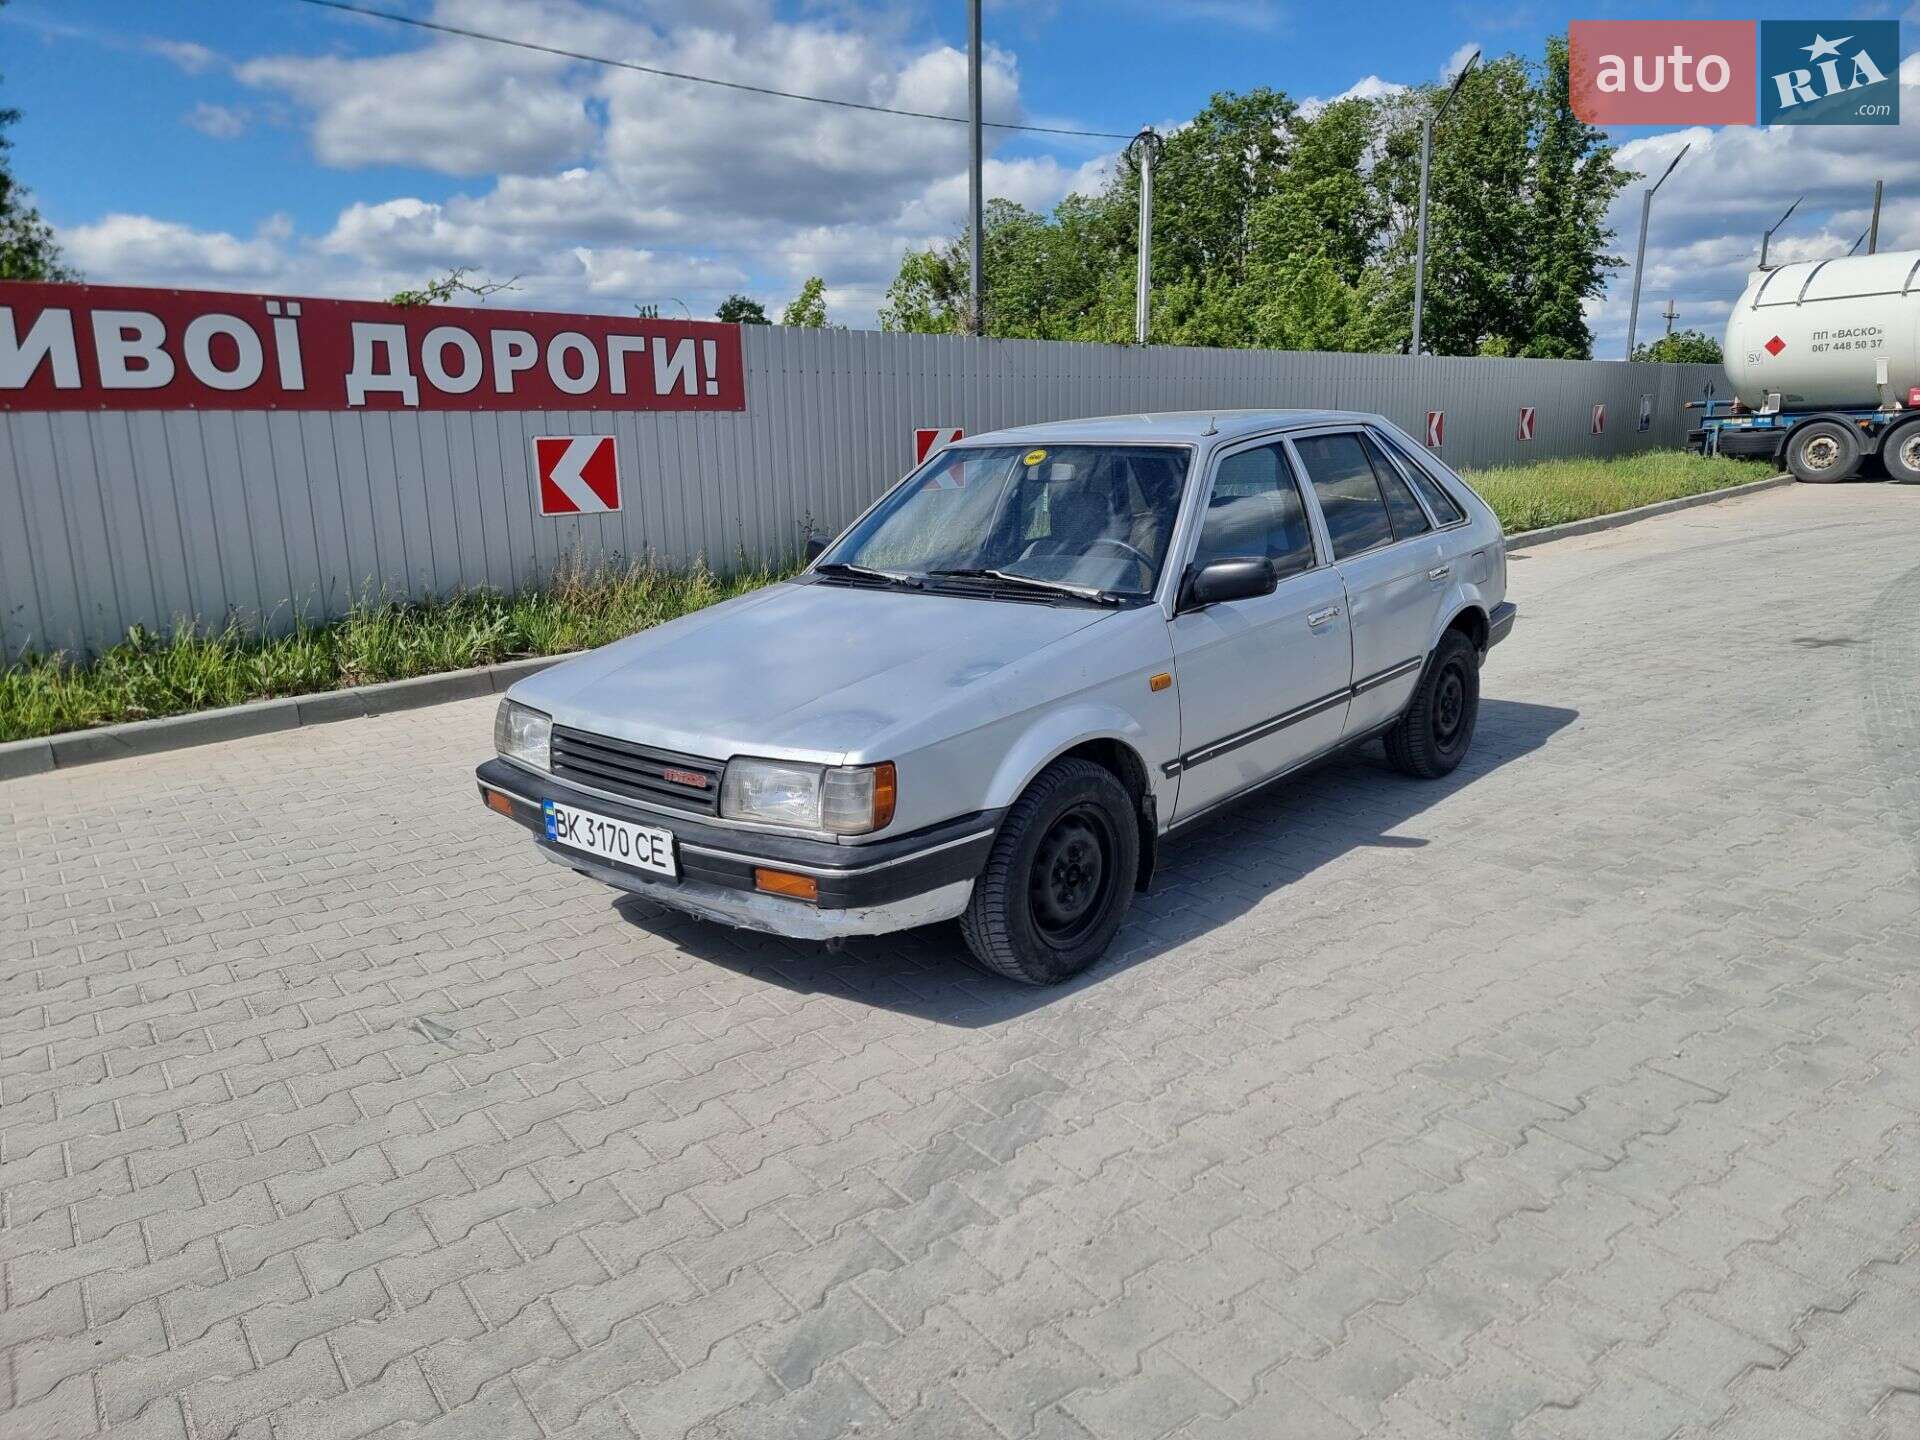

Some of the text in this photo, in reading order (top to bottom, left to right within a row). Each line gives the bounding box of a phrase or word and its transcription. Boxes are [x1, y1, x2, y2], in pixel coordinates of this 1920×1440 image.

[1812, 343, 1829, 352] 067
[1855, 340, 1867, 349] 50
[1870, 339, 1883, 348] 37
[1813, 331, 1829, 340] ПП
[0, 301, 720, 407] ИВОЇ ДОРОГИ!
[554, 808, 666, 868] BK 3170 CE
